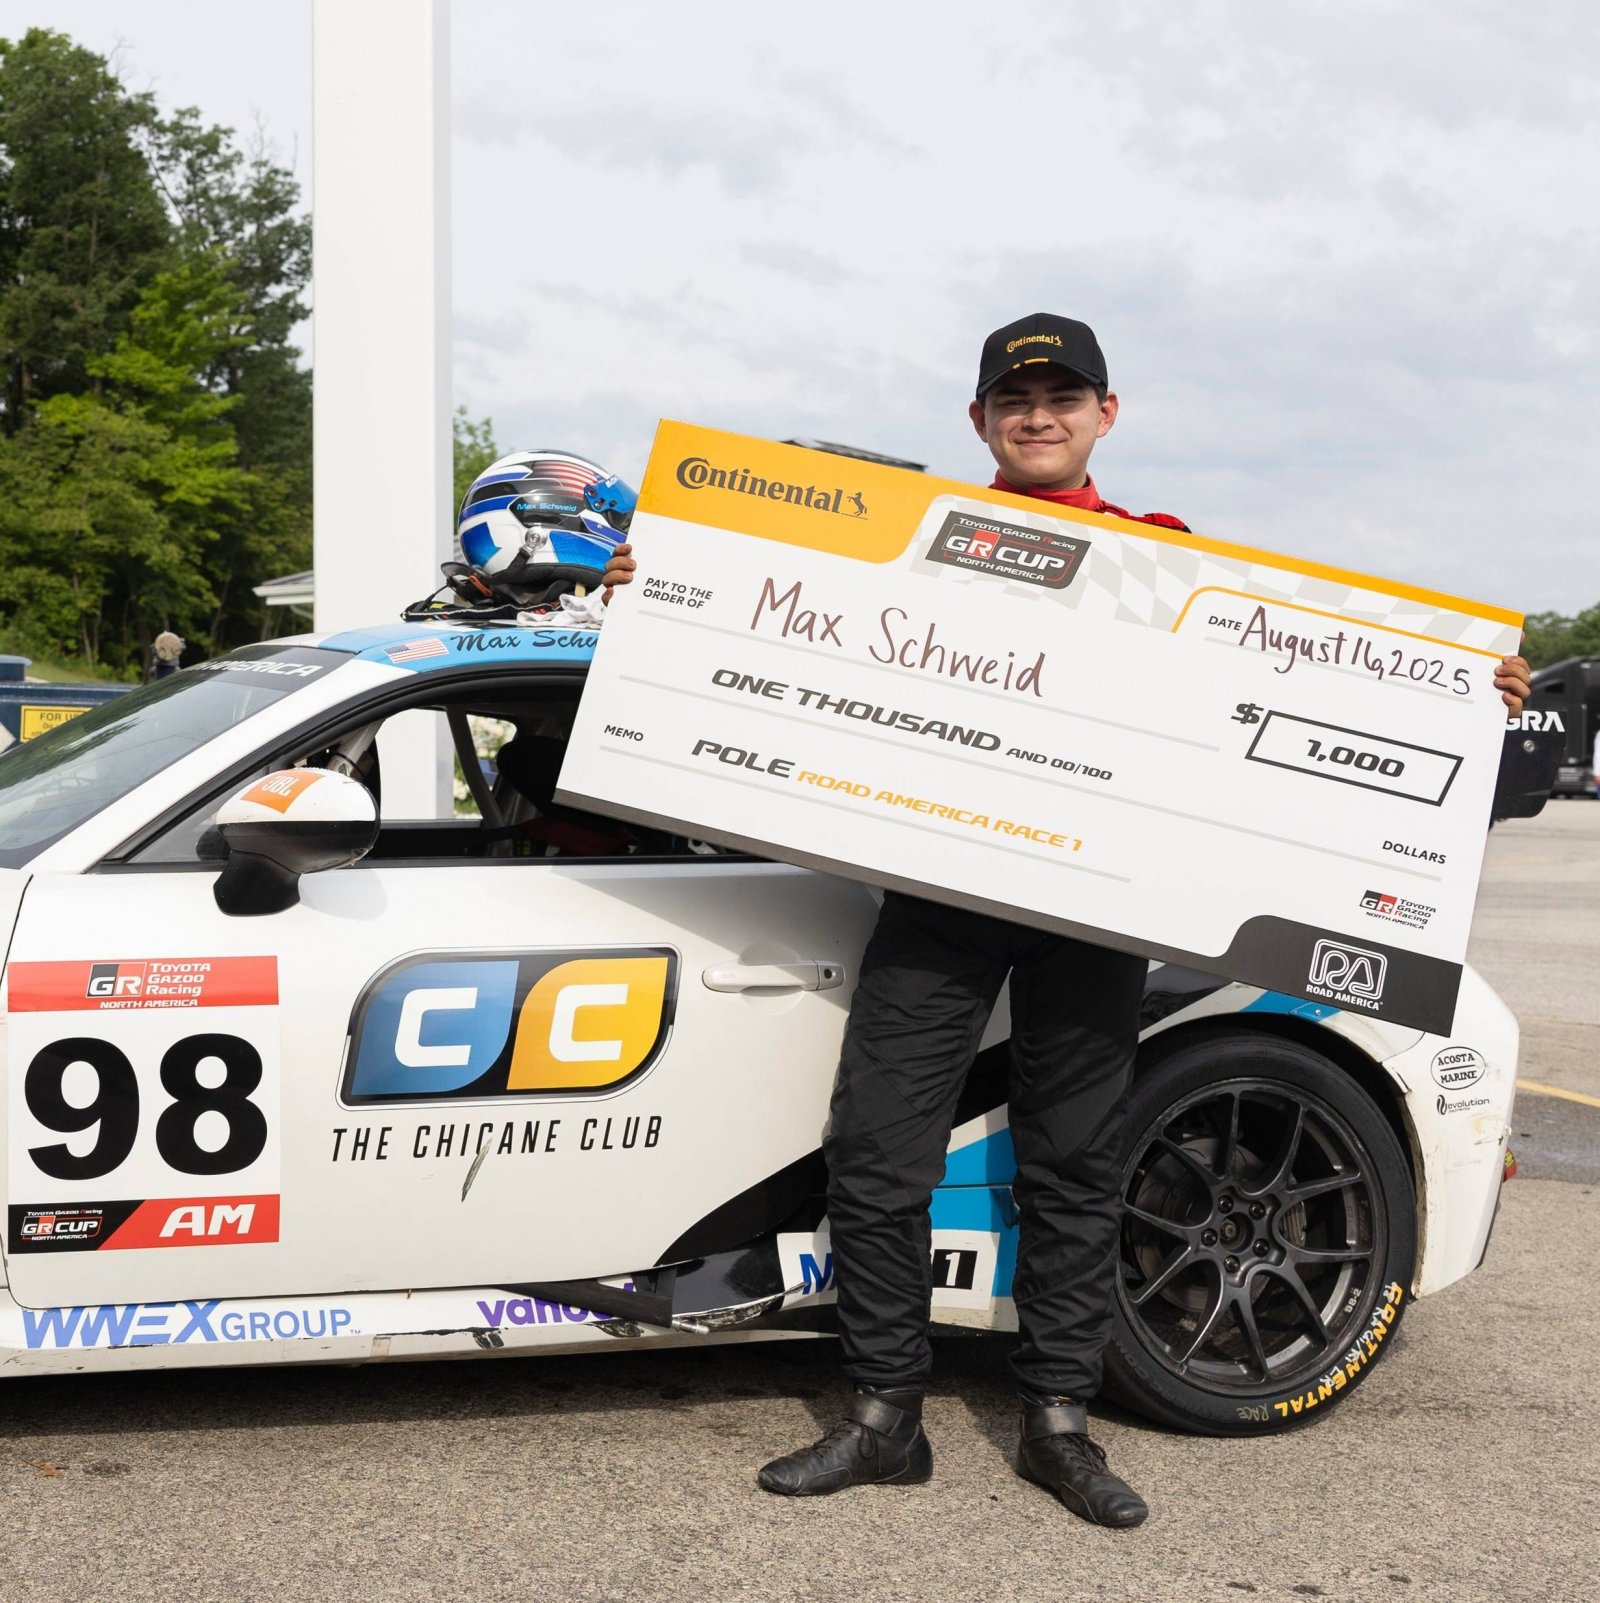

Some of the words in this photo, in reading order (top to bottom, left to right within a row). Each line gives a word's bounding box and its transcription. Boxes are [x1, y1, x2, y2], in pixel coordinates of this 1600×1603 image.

[1007, 335, 1053, 353] Continental
[676, 456, 842, 513] Continental
[516, 503, 536, 511] Max
[539, 502, 577, 512] Schweid
[959, 517, 1000, 533] TOYOTA
[1001, 528, 1041, 542] GAZOO
[1043, 537, 1076, 551] Racing
[946, 535, 993, 558] GR
[996, 547, 1065, 570] CUP
[957, 556, 994, 570] NORTH
[995, 565, 1045, 581] AMERICA
[643, 588, 685, 605] ORDER
[687, 598, 705, 609] OF
[645, 577, 669, 590] PAY
[671, 582, 687, 593] TO
[689, 586, 713, 600] THE
[1208, 615, 1242, 631] DATE
[450, 633, 521, 652] Max
[750, 576, 844, 648] Max
[869, 607, 1046, 698] Schweid
[1238, 605, 1347, 674] August
[40, 712, 61, 721] FOR
[711, 669, 789, 700] ONE
[797, 687, 1001, 751] THOUSAND
[1006, 748, 1048, 764] AND
[1050, 758, 1113, 780] 00/100
[603, 724, 644, 742] MEMO
[1231, 702, 1264, 724] $
[1306, 738, 1405, 778] 1,000
[262, 775, 299, 797] JBL
[690, 739, 796, 779] POLE
[797, 769, 872, 798] ROAD
[873, 789, 990, 829] AMERICA
[993, 819, 1068, 848] RACE
[1072, 838, 1082, 852] 1
[1381, 840, 1447, 865] DOLLARS
[1361, 897, 1394, 914] GR
[1400, 899, 1437, 913] TOYOTA
[1397, 905, 1431, 918] GAZOO
[1366, 911, 1391, 921] NORTH
[1391, 918, 1424, 930] AMERICA
[1394, 910, 1428, 924] Racing
[150, 962, 211, 973] TOYOTA
[89, 976, 141, 995] GR
[146, 984, 202, 997] Racing
[147, 974, 205, 984] GAZOO
[100, 1000, 141, 1009] NORTH
[144, 998, 198, 1008] AMERICA
[1306, 984, 1334, 998] ROAD
[1334, 992, 1379, 1010] AMERICA
[1438, 1052, 1475, 1066] ACOSTA
[1440, 1070, 1478, 1084] MARINE
[24, 1033, 268, 1180] 98
[332, 1127, 393, 1162] THE
[412, 1119, 561, 1158] CHICANE
[579, 1115, 662, 1151] CLUB
[23, 1223, 52, 1234] GR
[55, 1221, 98, 1233] CUP
[159, 1204, 256, 1238] AM
[221, 1309, 351, 1341] GROUP
